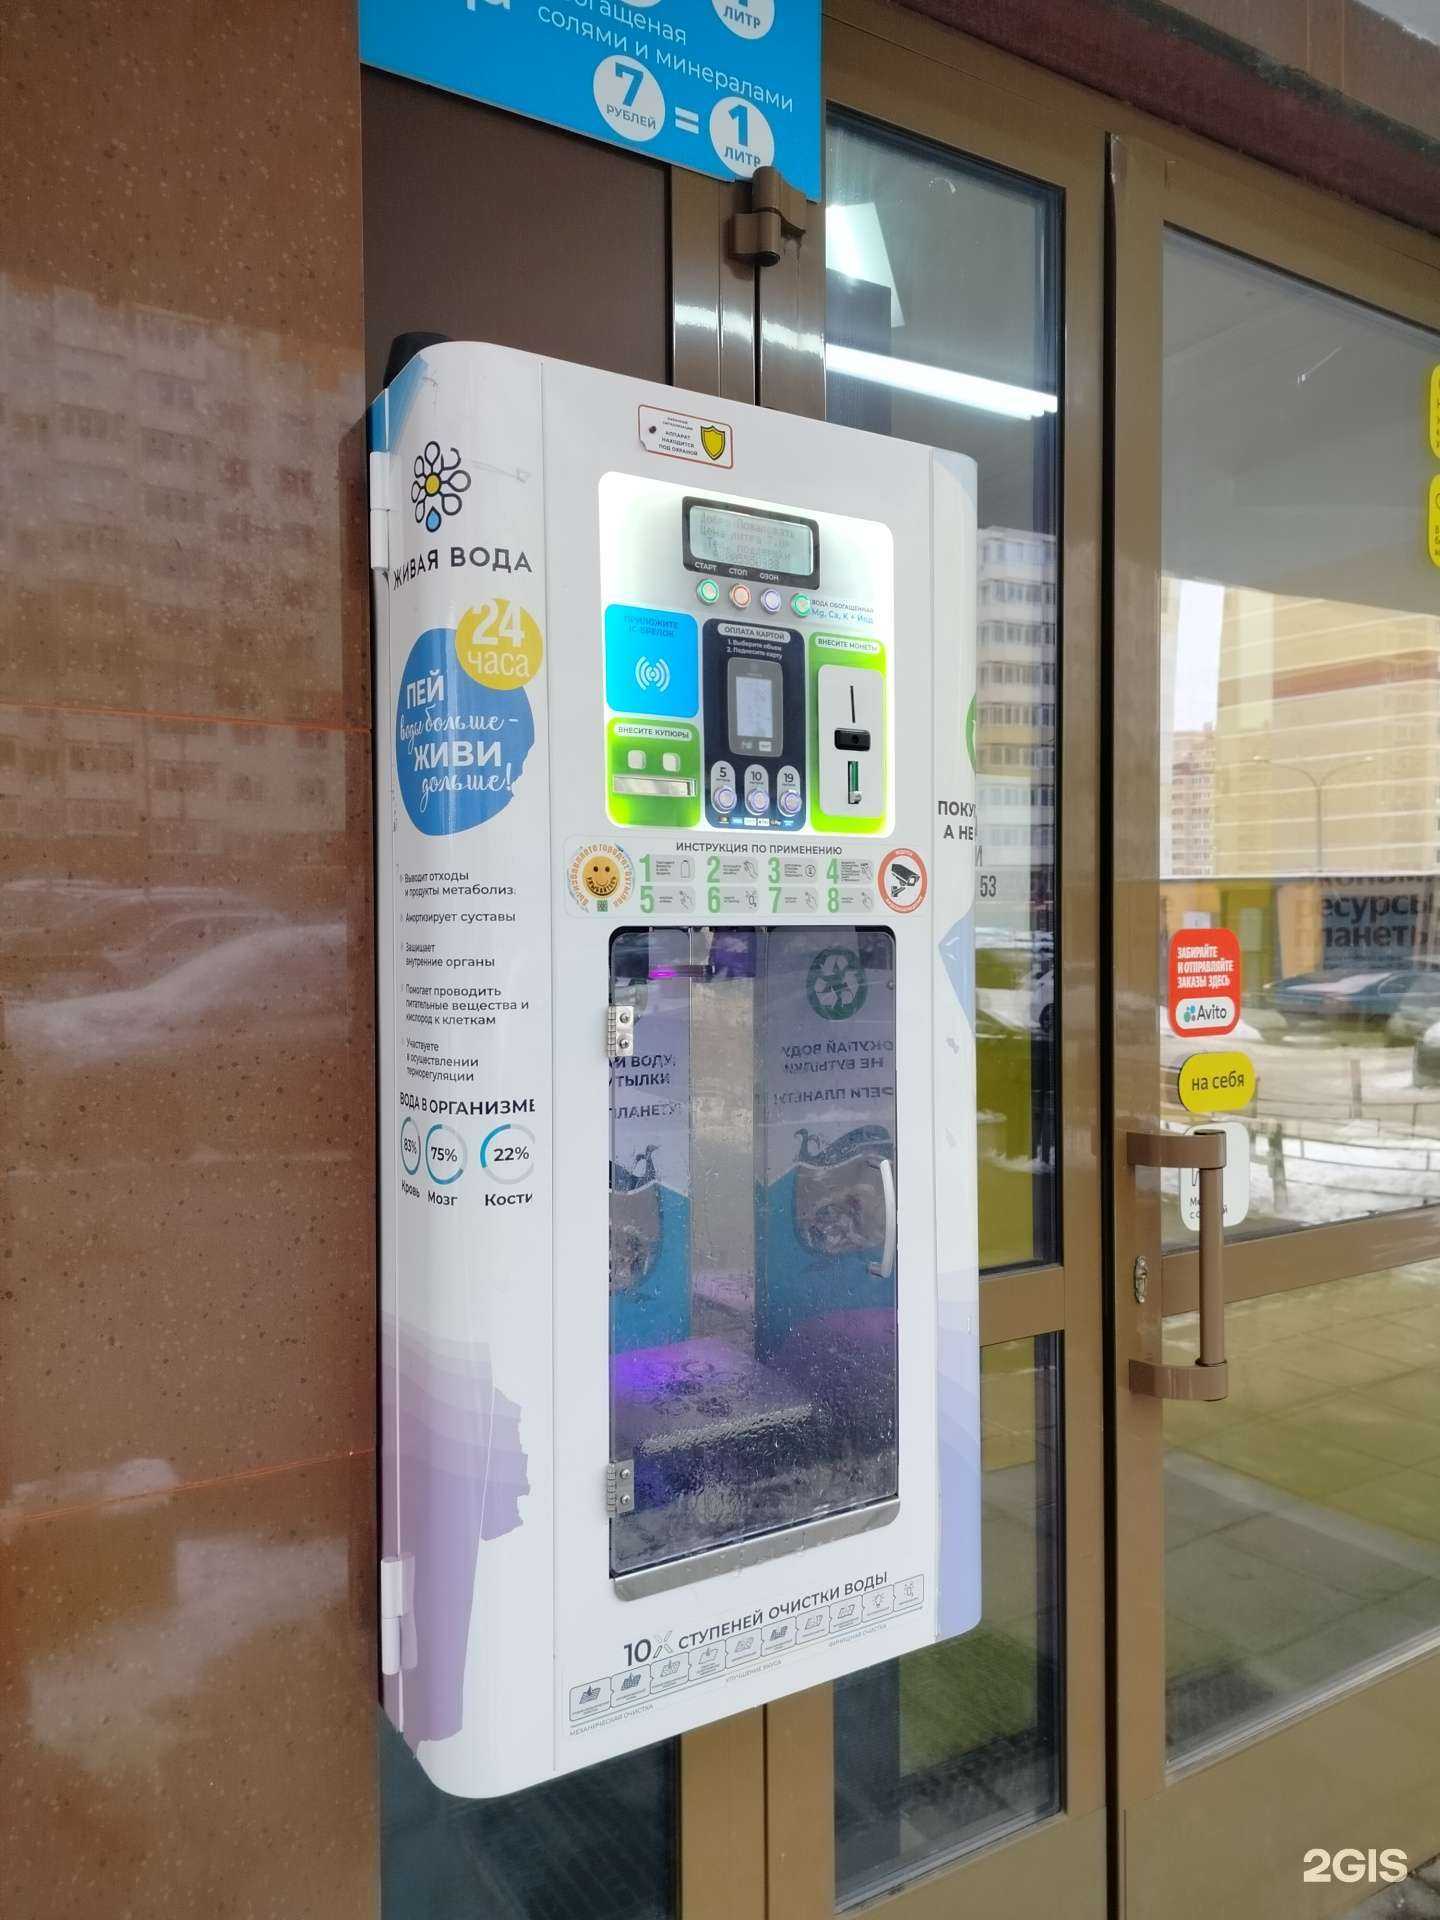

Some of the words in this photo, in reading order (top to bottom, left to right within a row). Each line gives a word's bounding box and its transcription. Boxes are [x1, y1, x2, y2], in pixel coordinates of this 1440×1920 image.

[723, 6, 761, 29] ЛИТР
[538, 5, 627, 52] солями
[635, 40, 649, 59] и
[656, 48, 793, 112] минералами
[615, 62, 644, 107] 7
[606, 103, 656, 130] РУБЛЕЙ
[728, 104, 748, 147] 1
[724, 147, 761, 166] ЛИТР
[393, 549, 438, 591] ЖИВАЯ
[450, 546, 533, 574] ВОДА
[695, 562, 717, 572] СТАРТ
[728, 568, 748, 576] СТОП
[759, 572, 779, 581] ОЗОН
[471, 598, 525, 648] 24
[724, 626, 755, 636] ОПЛАТА
[756, 630, 785, 640] КАРТОЙ
[818, 639, 848, 647] ВНЕСИТЕ
[467, 648, 531, 678] часа
[407, 668, 445, 709] ПЕЙ
[425, 703, 505, 732] больше
[618, 727, 653, 735] ВНЕСИТЕ
[655, 730, 689, 738] КУПЮРЫ
[413, 740, 501, 772] ЖИВИ
[719, 767, 727, 778] 5
[751, 771, 762, 781] 10
[784, 774, 794, 783] 19
[419, 762, 512, 813] дольше!
[944, 825, 954, 839] А
[959, 825, 974, 840] НЕ
[676, 843, 748, 854] ИНСТРУКЦИЯ
[751, 845, 767, 854] ПО
[769, 845, 843, 855] ПРИМЕНЕНИЮ
[429, 872, 469, 883] отходы
[639, 854, 651, 882] 1
[707, 856, 721, 883] 2
[768, 857, 781, 884] 3
[827, 858, 840, 884] 4
[442, 884, 516, 895] метаболиз
[980, 875, 996, 897] 53
[640, 886, 655, 913] 5
[707, 887, 721, 913] 6
[768, 887, 782, 913] 7
[828, 887, 840, 913] 8
[460, 913, 516, 924] суставы
[1177, 944, 1219, 959] ЗАБИРАЙТЕ
[445, 958, 495, 969] органы
[1184, 958, 1234, 973] ОТПРАВЛЯЙТЕ
[433, 987, 502, 998] проводить
[1177, 976, 1207, 989] ЗАКАЗЫ
[1208, 974, 1231, 989] ЗДЕСЬ
[405, 1000, 449, 1011] питательные
[452, 1000, 517, 1012] вещества
[521, 1001, 529, 1009] и
[1197, 1004, 1227, 1020] Avito
[406, 1013, 432, 1024] кислород
[442, 1016, 496, 1025] клеткам
[411, 1053, 479, 1067] осуществлении
[1191, 1076, 1209, 1092] на
[1212, 1070, 1245, 1090] себя
[400, 1092, 420, 1110] ВОДА
[429, 1098, 536, 1115] ОРГАНИЗМЕ
[403, 1137, 417, 1154] 83%
[430, 1146, 458, 1162] 75%
[493, 1146, 529, 1162] 22%
[401, 1178, 420, 1198] Кровь
[428, 1190, 458, 1206] Мозг
[484, 1193, 533, 1206] Кости
[678, 1609, 763, 1649] СТУПЕНЕЙ
[768, 1586, 840, 1620] ОЧИСТКИ
[844, 1571, 887, 1596] ВОДЫ
